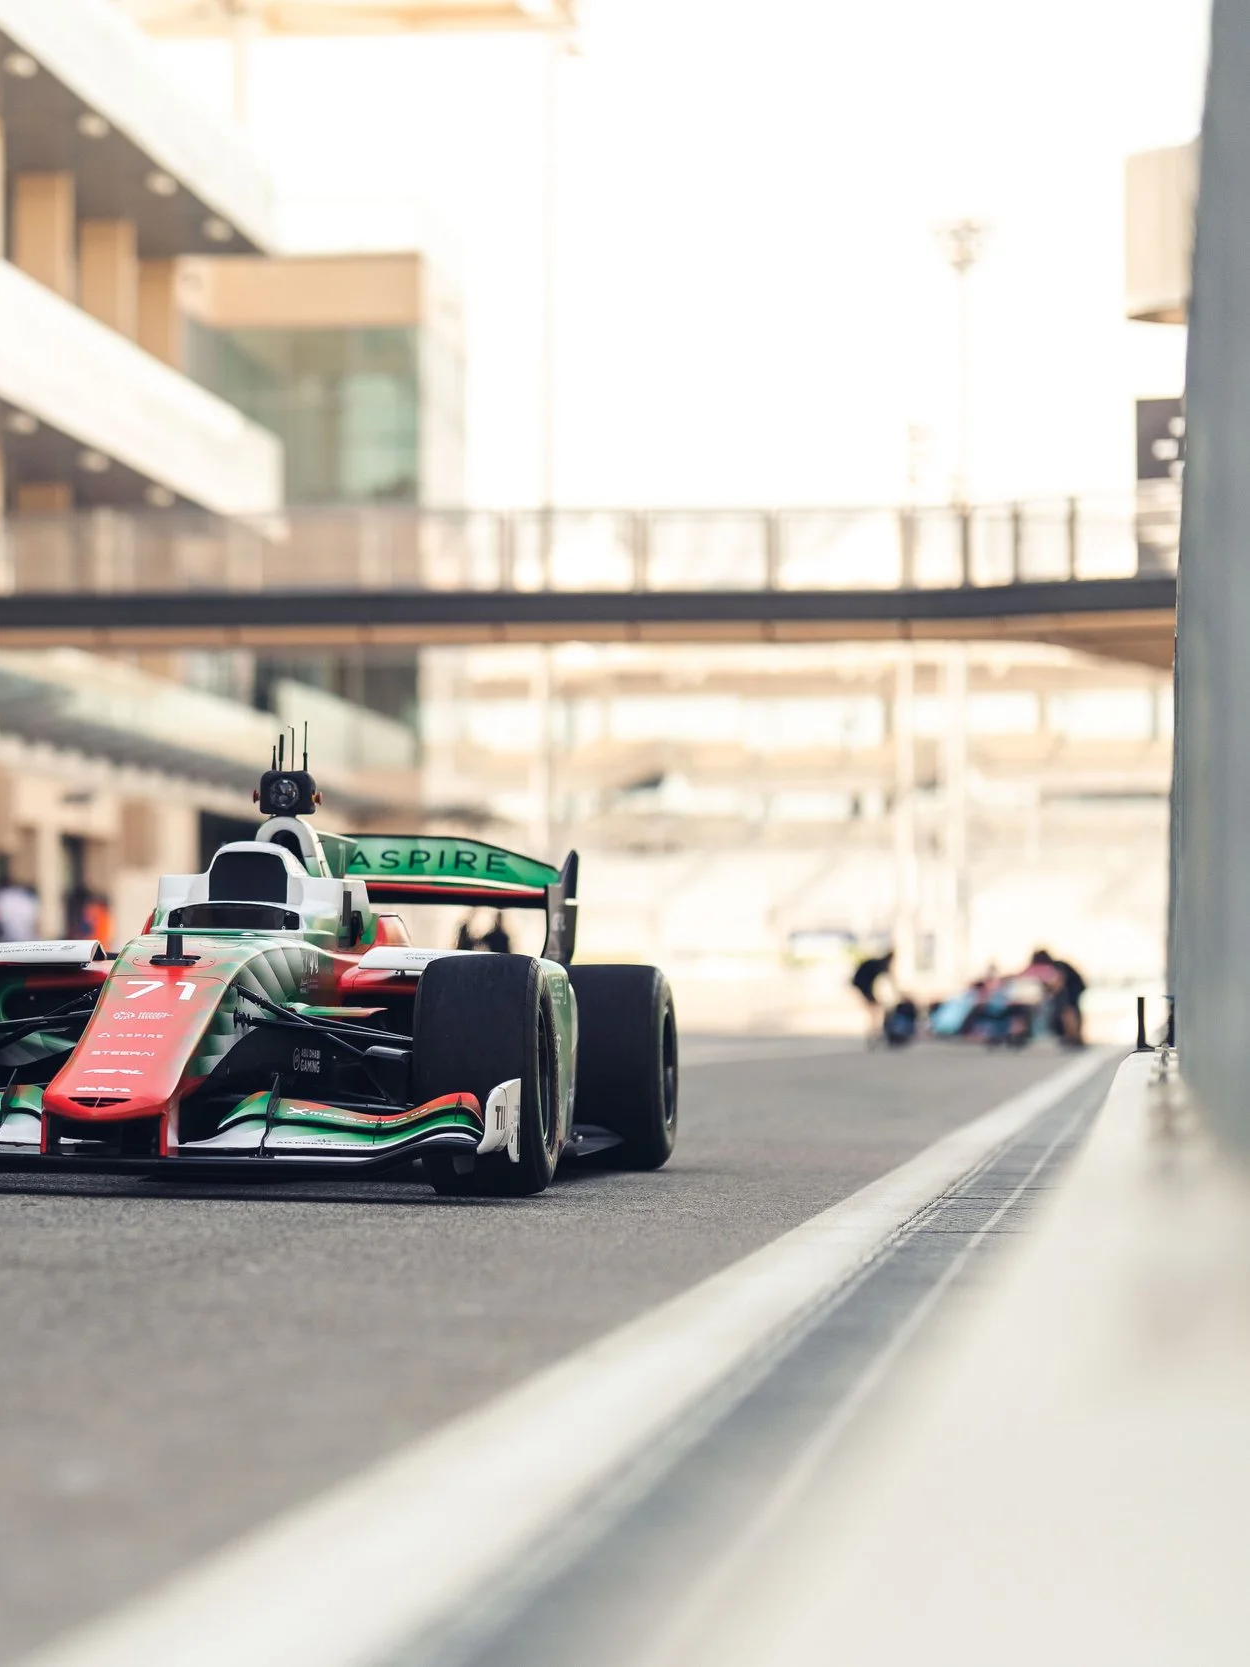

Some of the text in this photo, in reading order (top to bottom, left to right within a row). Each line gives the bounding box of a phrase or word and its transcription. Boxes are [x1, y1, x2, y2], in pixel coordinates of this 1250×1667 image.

[349, 850, 509, 874] ASPIRE
[125, 980, 197, 1001] 71
[301, 1048, 321, 1059] ABU DHABI
[300, 1059, 320, 1073] GAMING
